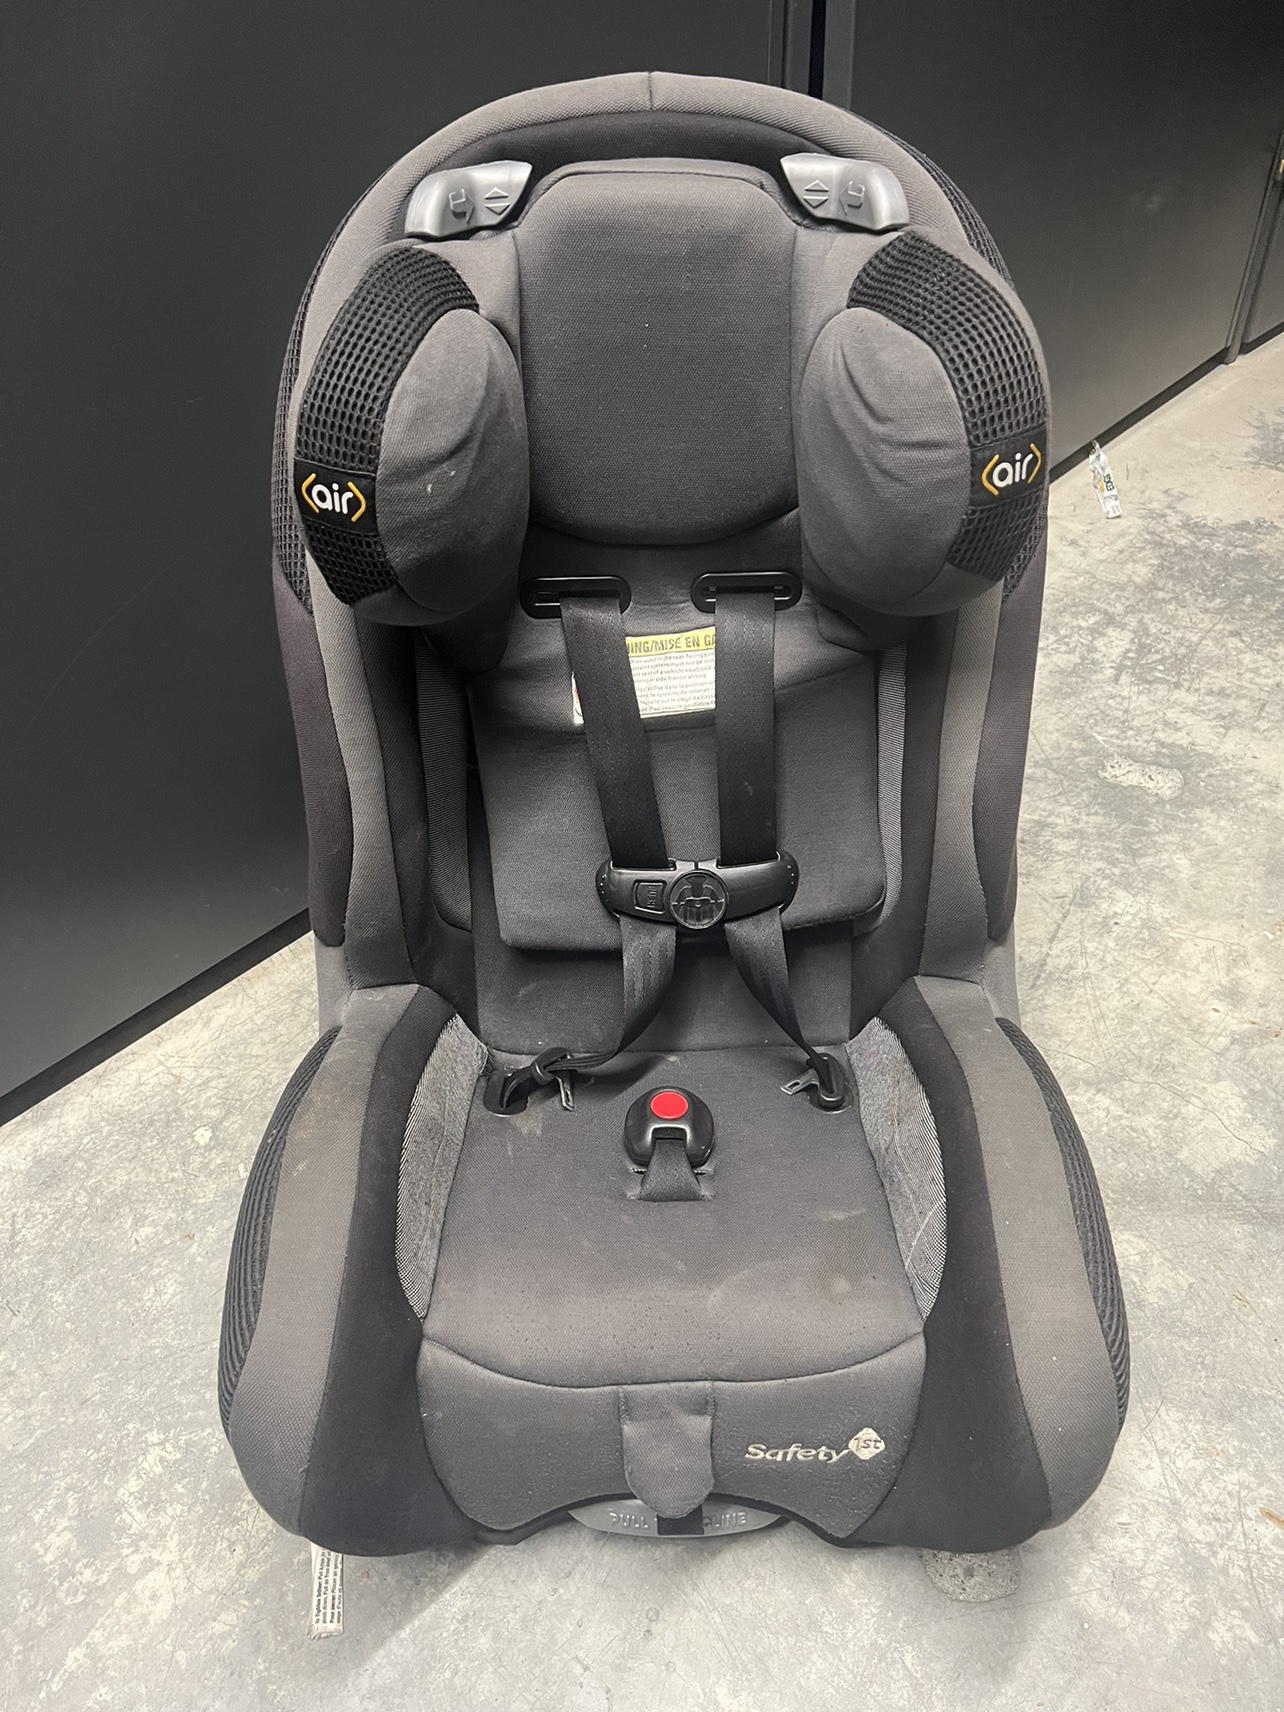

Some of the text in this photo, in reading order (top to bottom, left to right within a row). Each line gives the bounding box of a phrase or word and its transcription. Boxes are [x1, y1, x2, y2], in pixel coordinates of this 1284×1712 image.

[993, 452, 1033, 488] air
[311, 483, 354, 515] air
[685, 634, 700, 648] EN
[744, 1437, 882, 1464] Safety 1st
